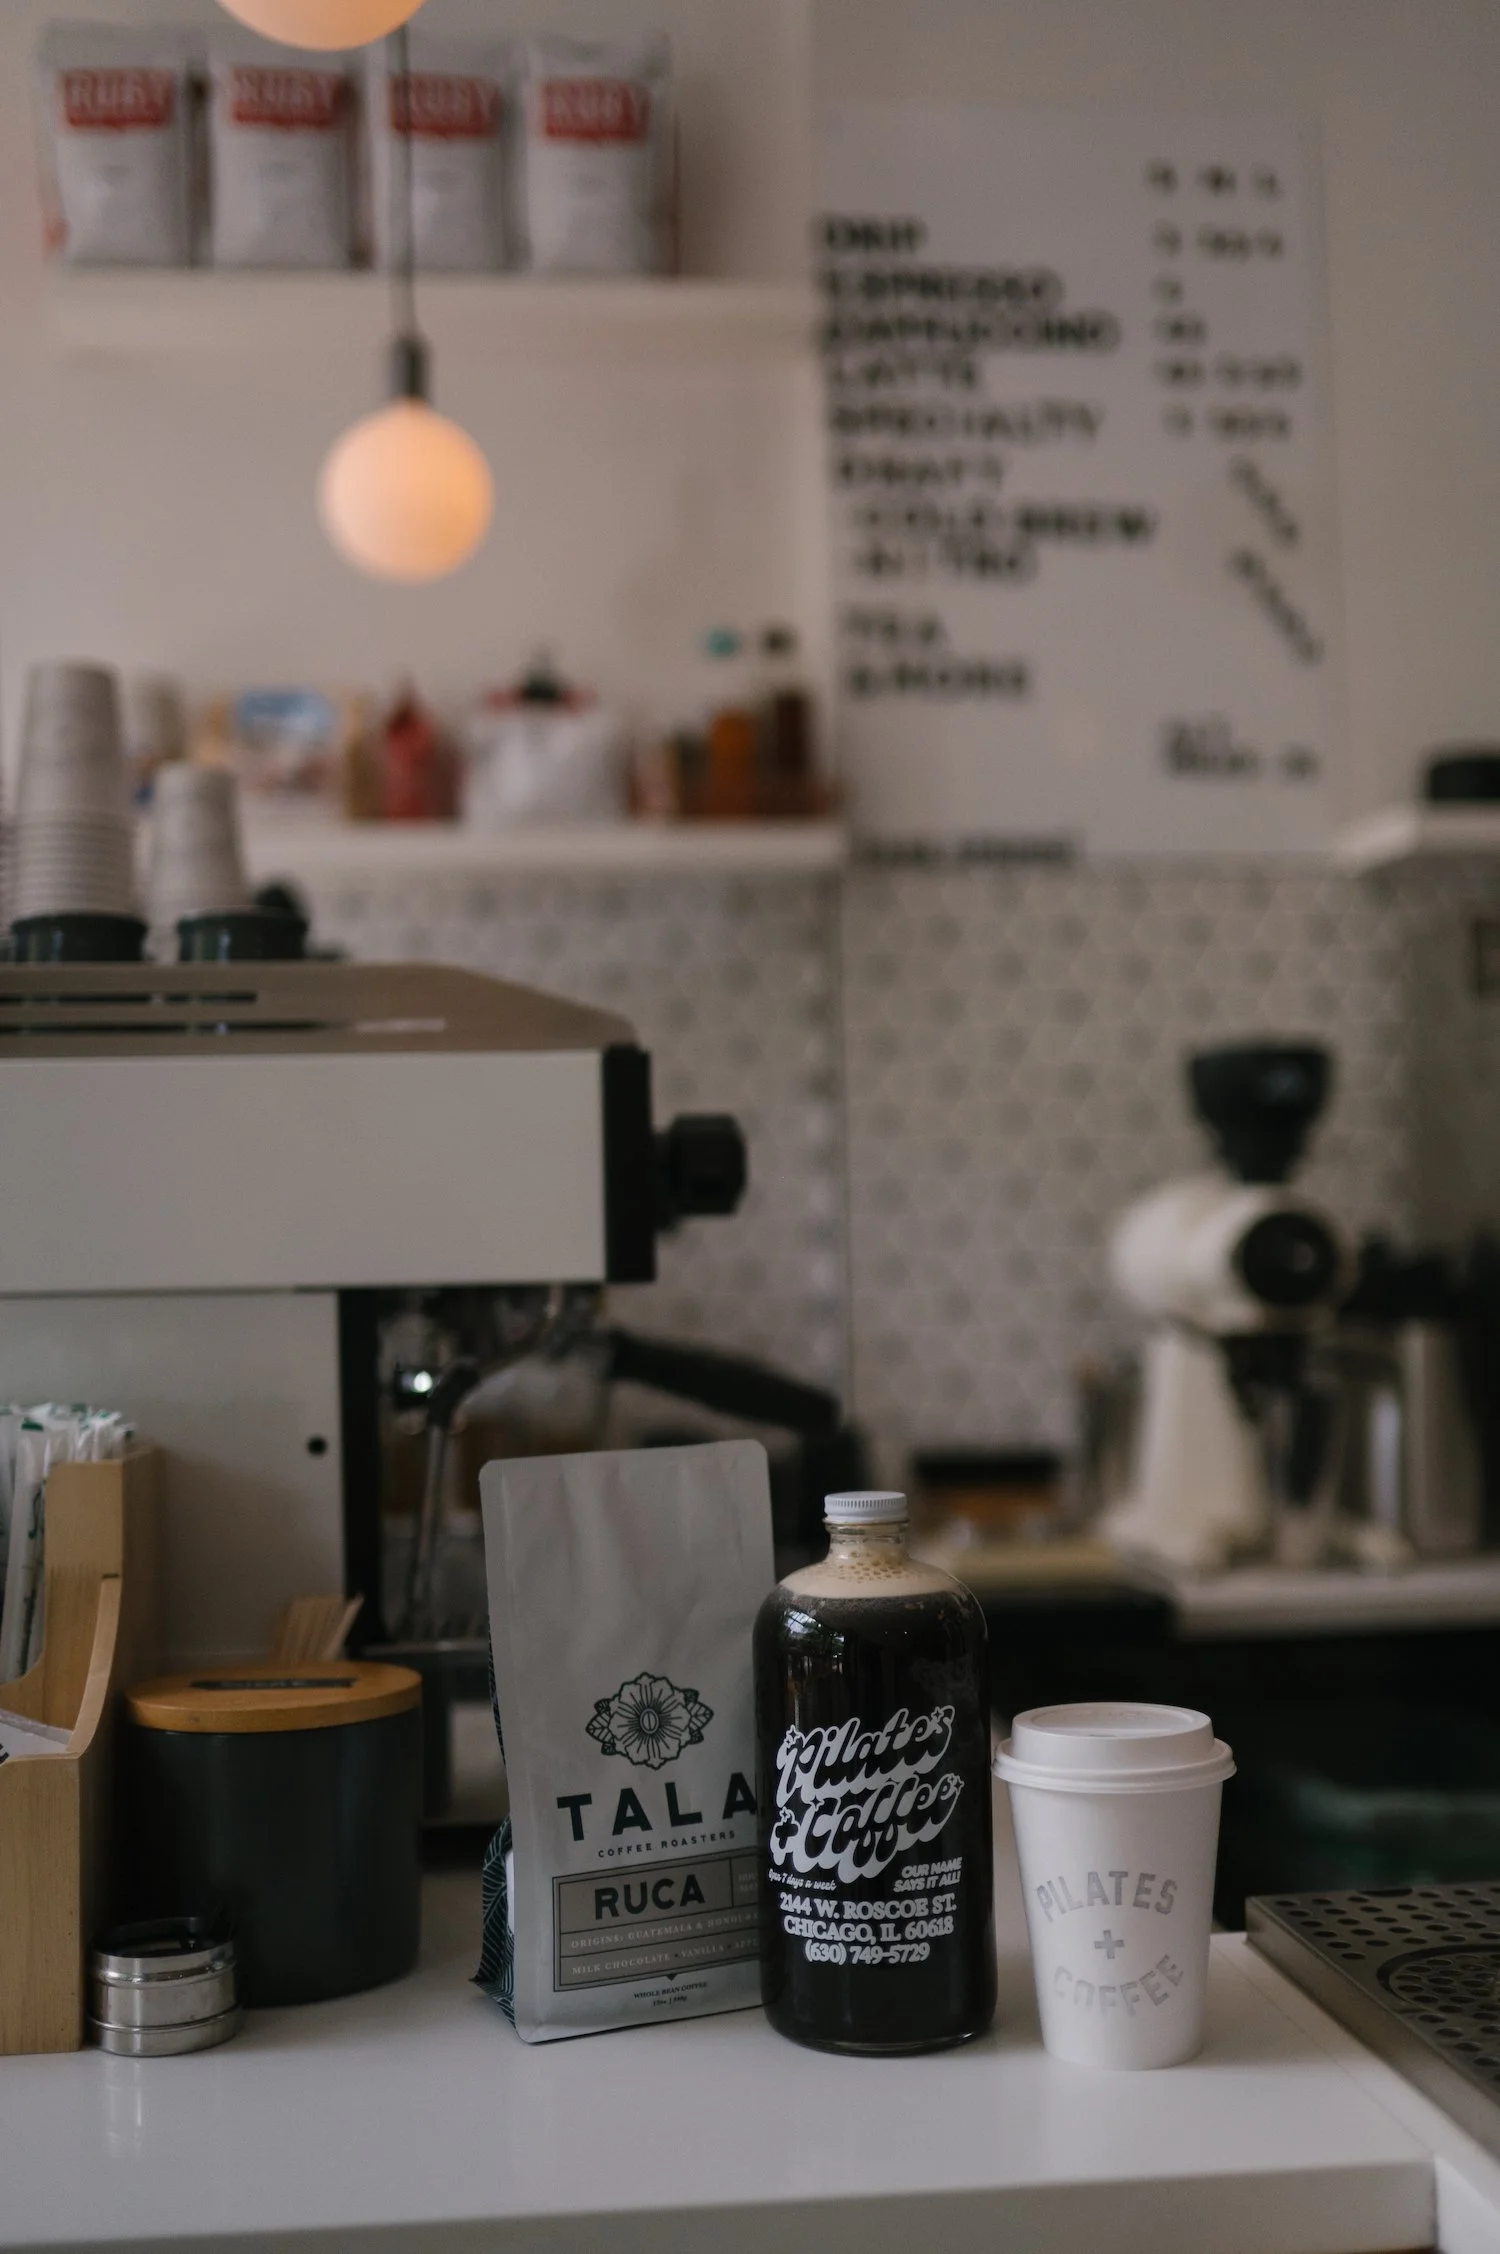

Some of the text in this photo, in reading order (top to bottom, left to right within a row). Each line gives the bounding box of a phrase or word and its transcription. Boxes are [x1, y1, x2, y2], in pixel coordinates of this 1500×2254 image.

[822, 268, 1060, 306] ESPRESSO
[822, 312, 1118, 350] CAPPUCCINO
[556, 1772, 757, 1842] TALA
[597, 1829, 736, 1858] COFFEE ROASTERS
[786, 1873, 805, 1889] days
[813, 1879, 837, 1891] week
[893, 1870, 961, 1893] SAYS IT ALL!
[901, 1856, 963, 1879] OUR NAME
[594, 1874, 705, 1921] RUCA
[779, 1892, 957, 1920] 2144 W. ROSCOE ST.
[1035, 1871, 1178, 1923] PILATES
[783, 1915, 955, 1945] CHICAGO, IL 60618
[572, 1963, 602, 1976] MILK
[604, 1951, 672, 1971] CHOCOLATE
[804, 1939, 931, 1966] (630) 749-5729
[633, 1990, 660, 2000] WHOLE
[661, 1986, 680, 1996] BEAN
[1053, 1954, 1185, 2018] COFFEE
